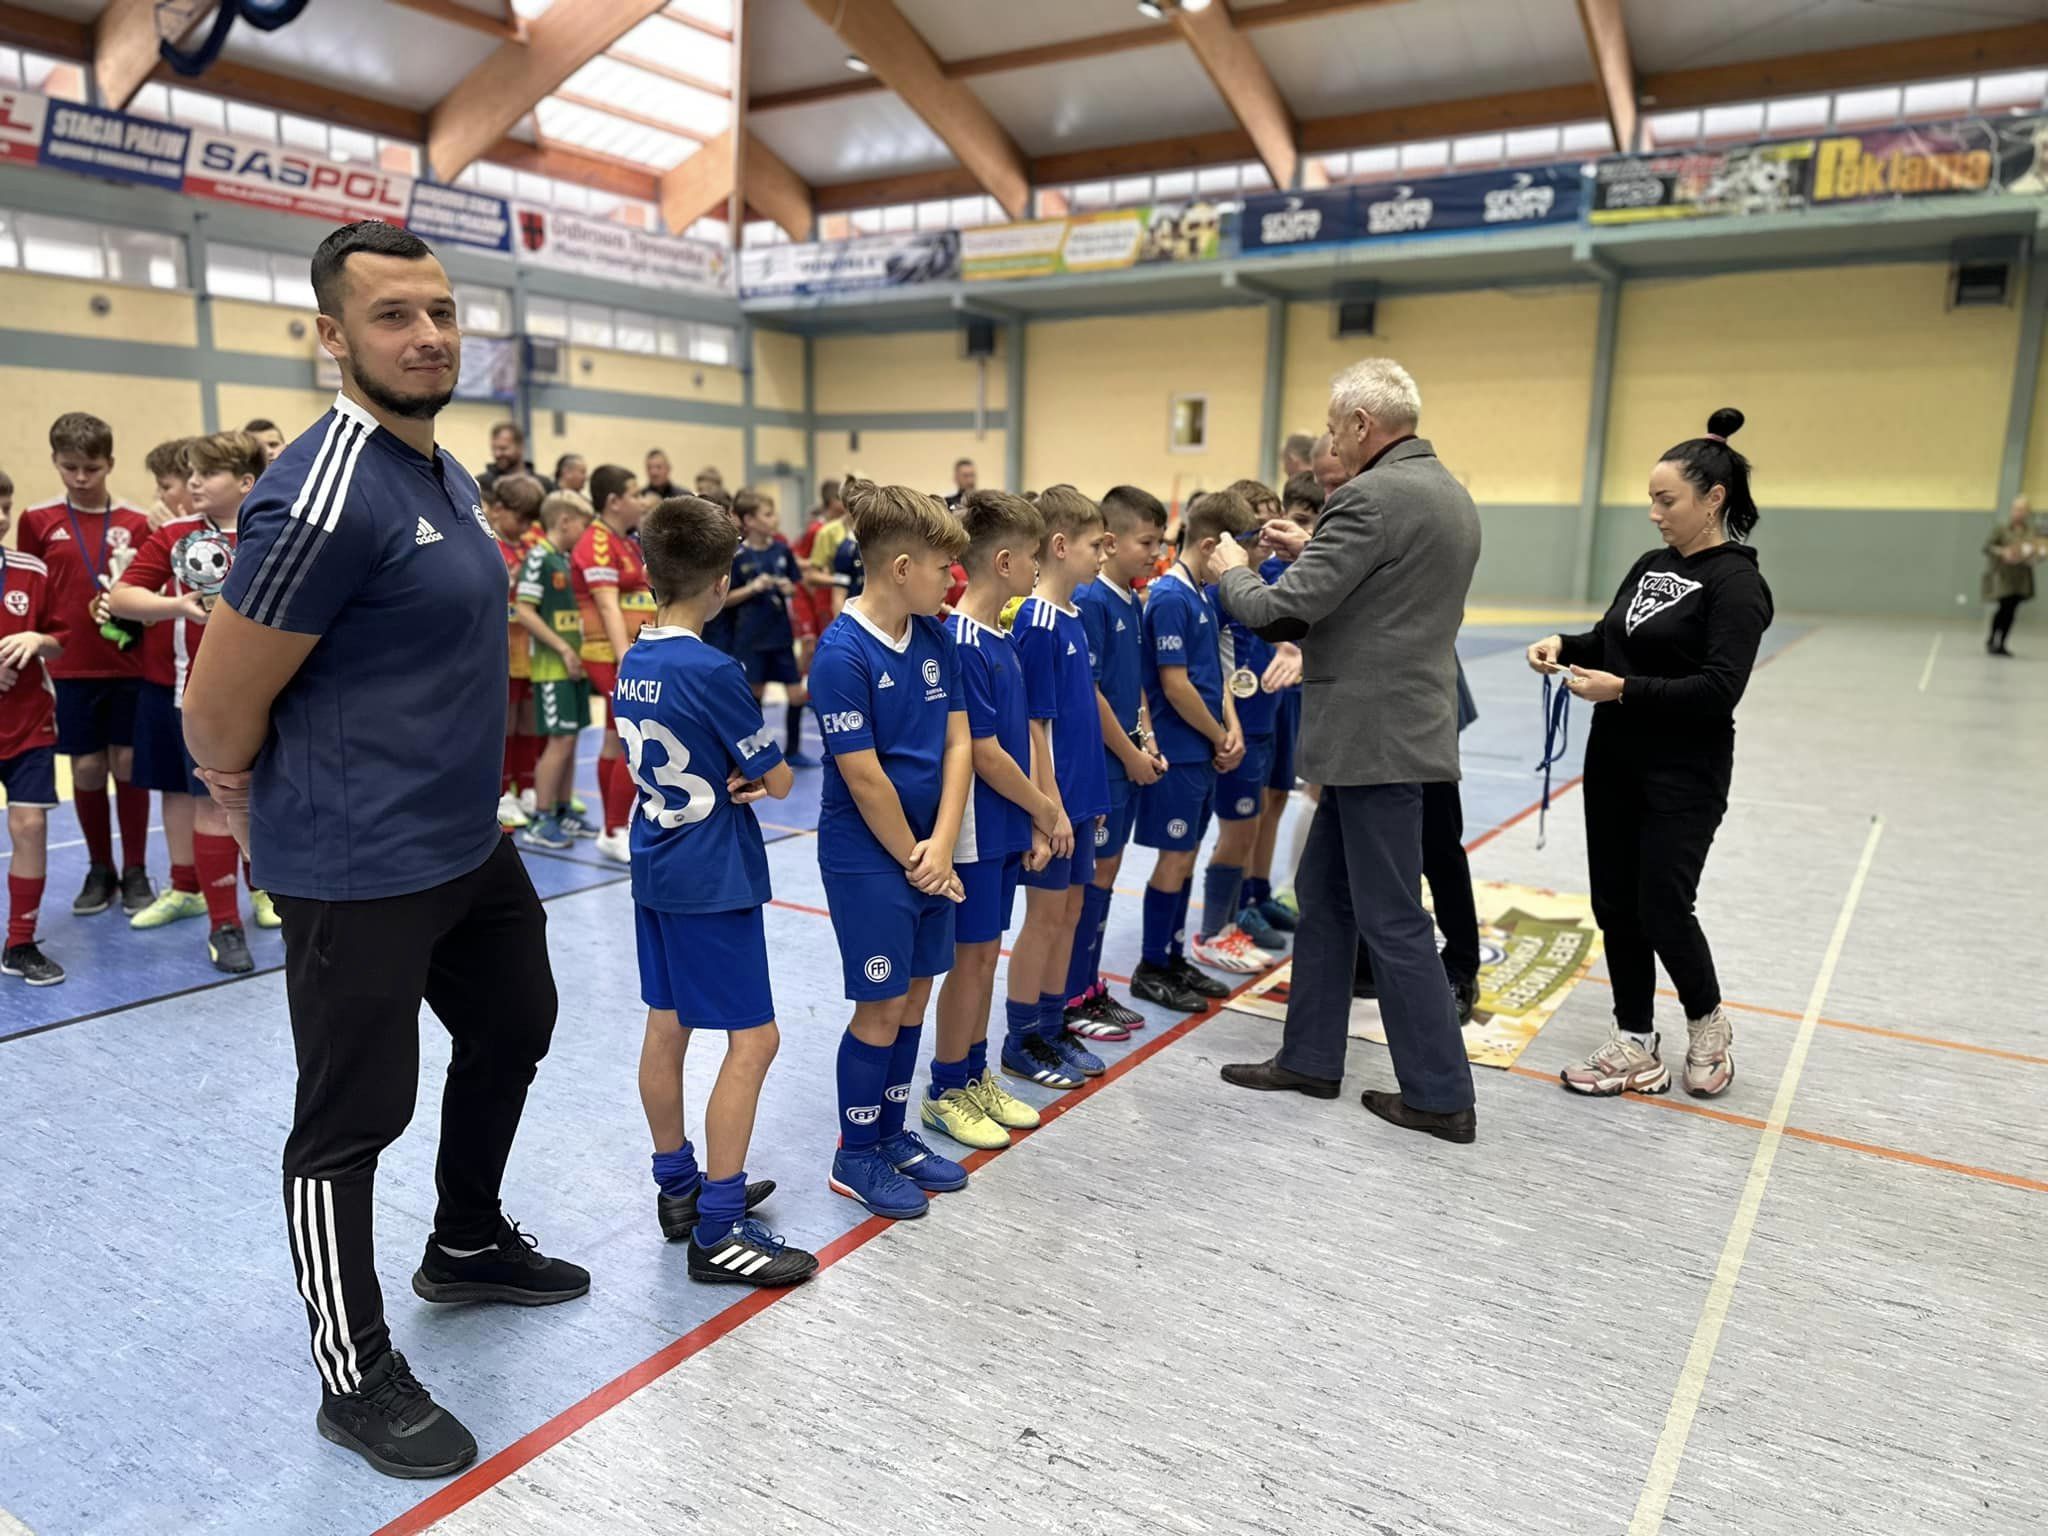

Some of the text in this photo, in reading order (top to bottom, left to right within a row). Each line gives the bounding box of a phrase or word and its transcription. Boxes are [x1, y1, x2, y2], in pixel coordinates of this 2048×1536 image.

[202, 140, 403, 207] SASPOL
[1643, 577, 1686, 599] GUESS
[617, 679, 662, 704] MACIEJ
